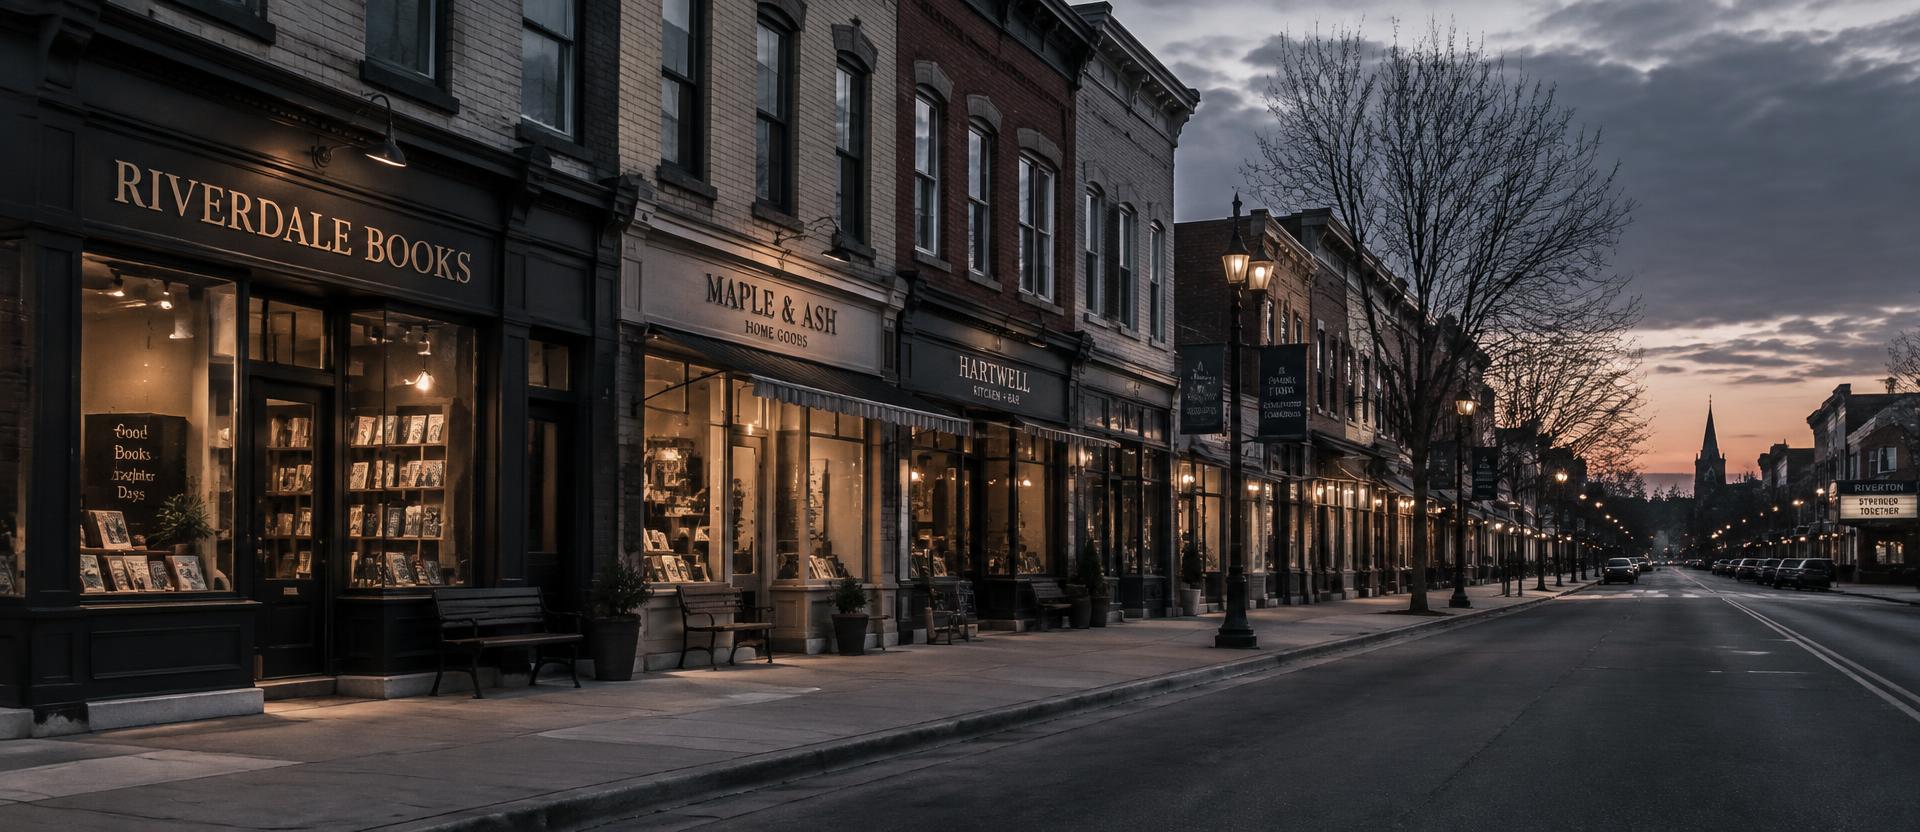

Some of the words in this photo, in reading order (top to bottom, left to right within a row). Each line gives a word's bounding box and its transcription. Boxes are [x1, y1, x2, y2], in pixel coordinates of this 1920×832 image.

[114, 159, 352, 256] RIVERDALE
[364, 225, 472, 284] BOOKS
[706, 273, 775, 319] MAPLE
[782, 295, 796, 325] &
[801, 302, 838, 335] ASH
[745, 320, 774, 340] HOME
[959, 355, 1030, 393] HARTWELL
[115, 444, 151, 460] Books
[1854, 483, 1904, 492] RIVERTON
